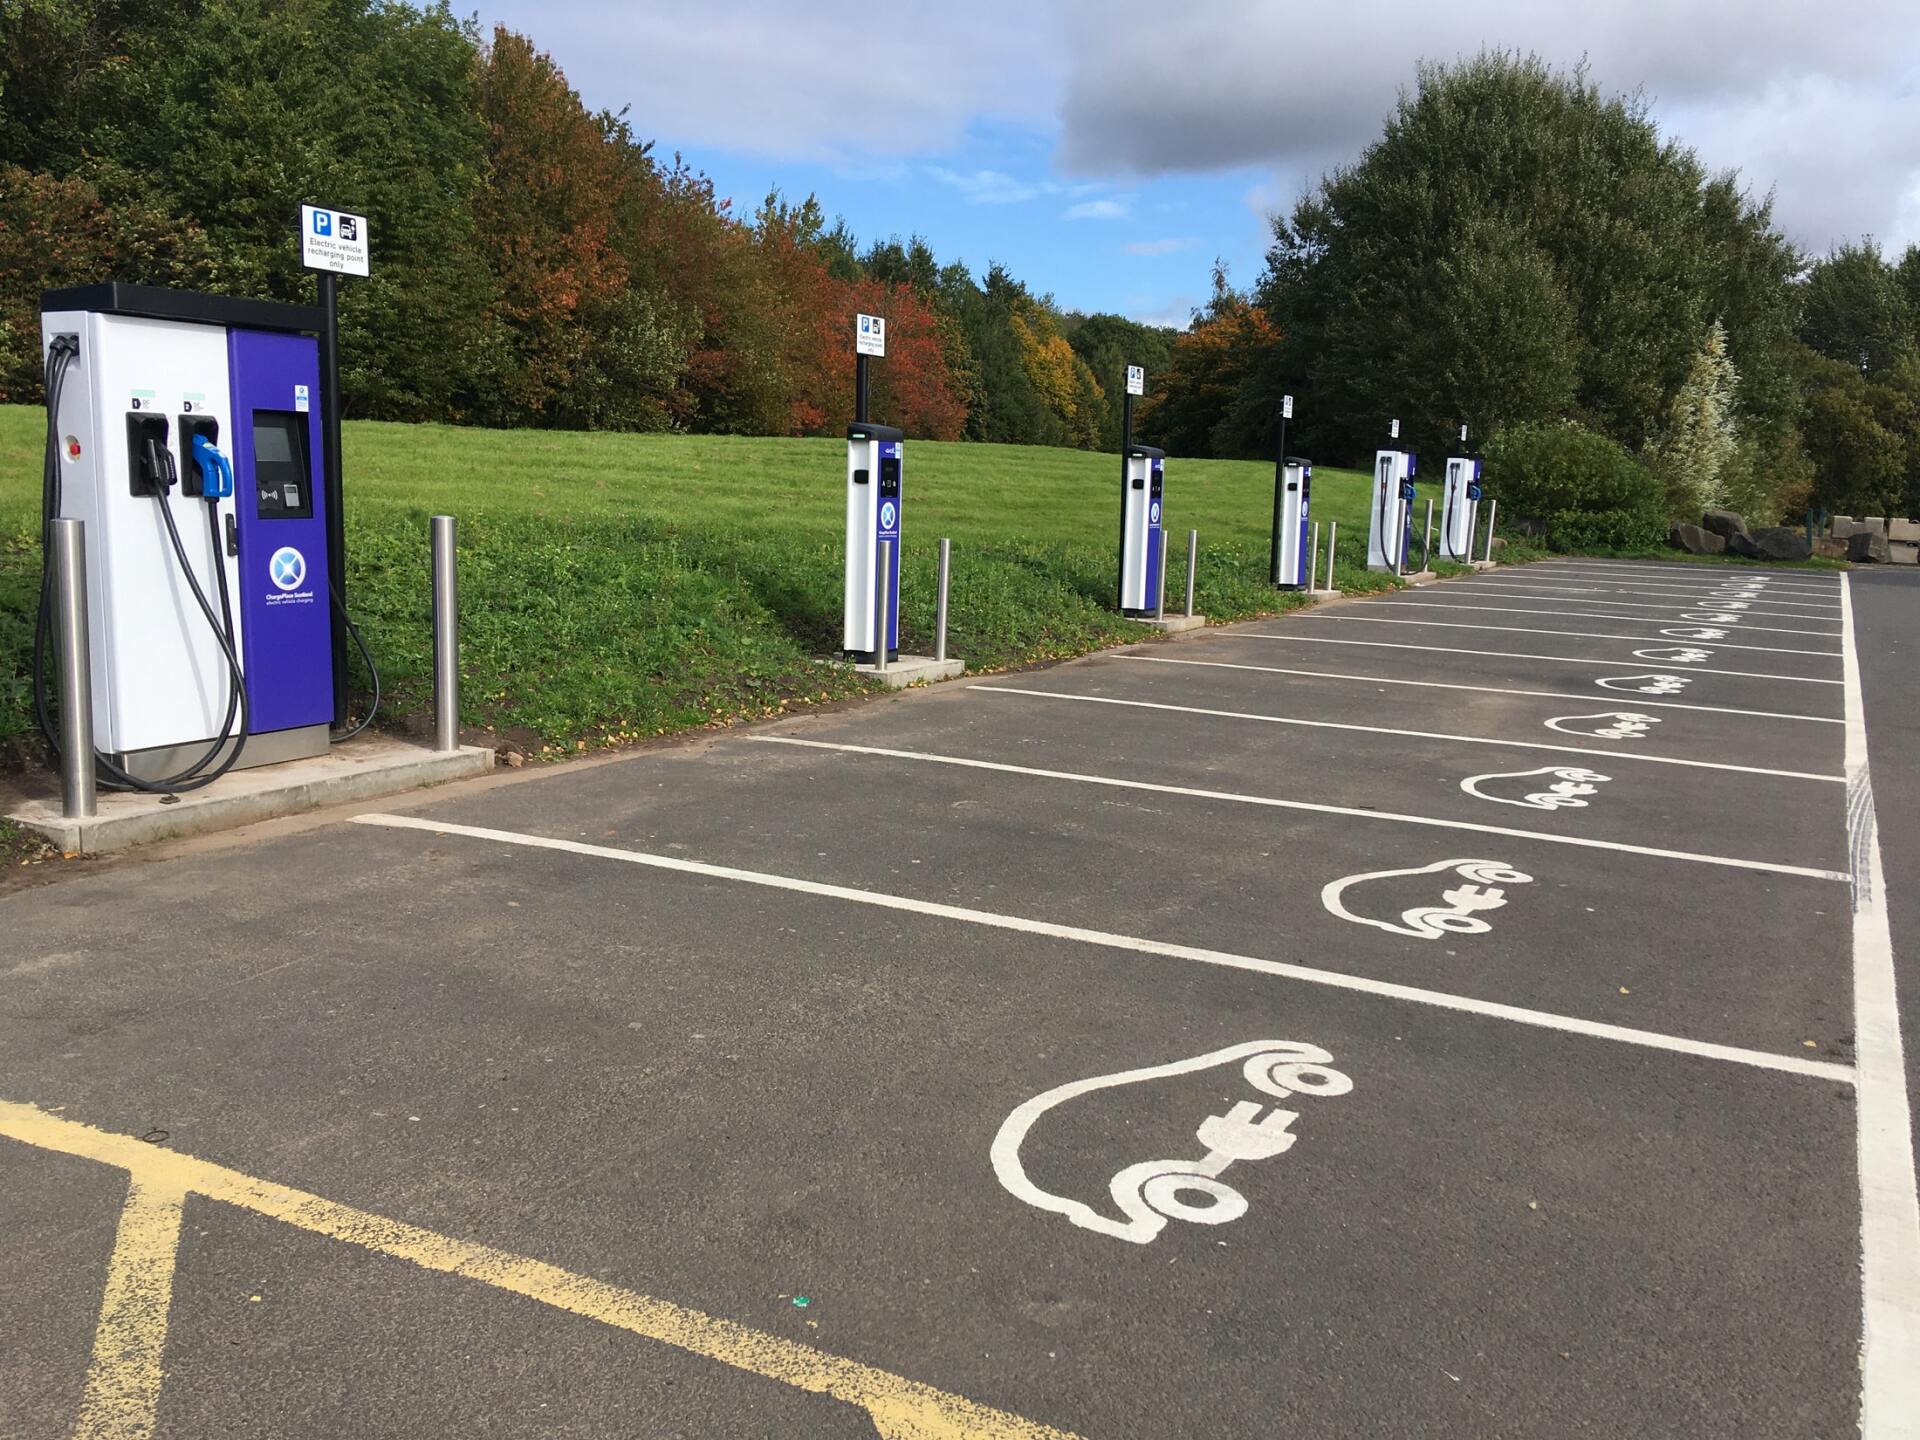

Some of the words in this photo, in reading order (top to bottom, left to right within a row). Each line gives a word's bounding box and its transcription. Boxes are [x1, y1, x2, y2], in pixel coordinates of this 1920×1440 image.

[316, 213, 328, 233] P
[309, 237, 337, 249] Electric
[338, 243, 362, 254] vehicle
[307, 247, 345, 260] recharging
[346, 254, 364, 263] point
[329, 260, 344, 269] only
